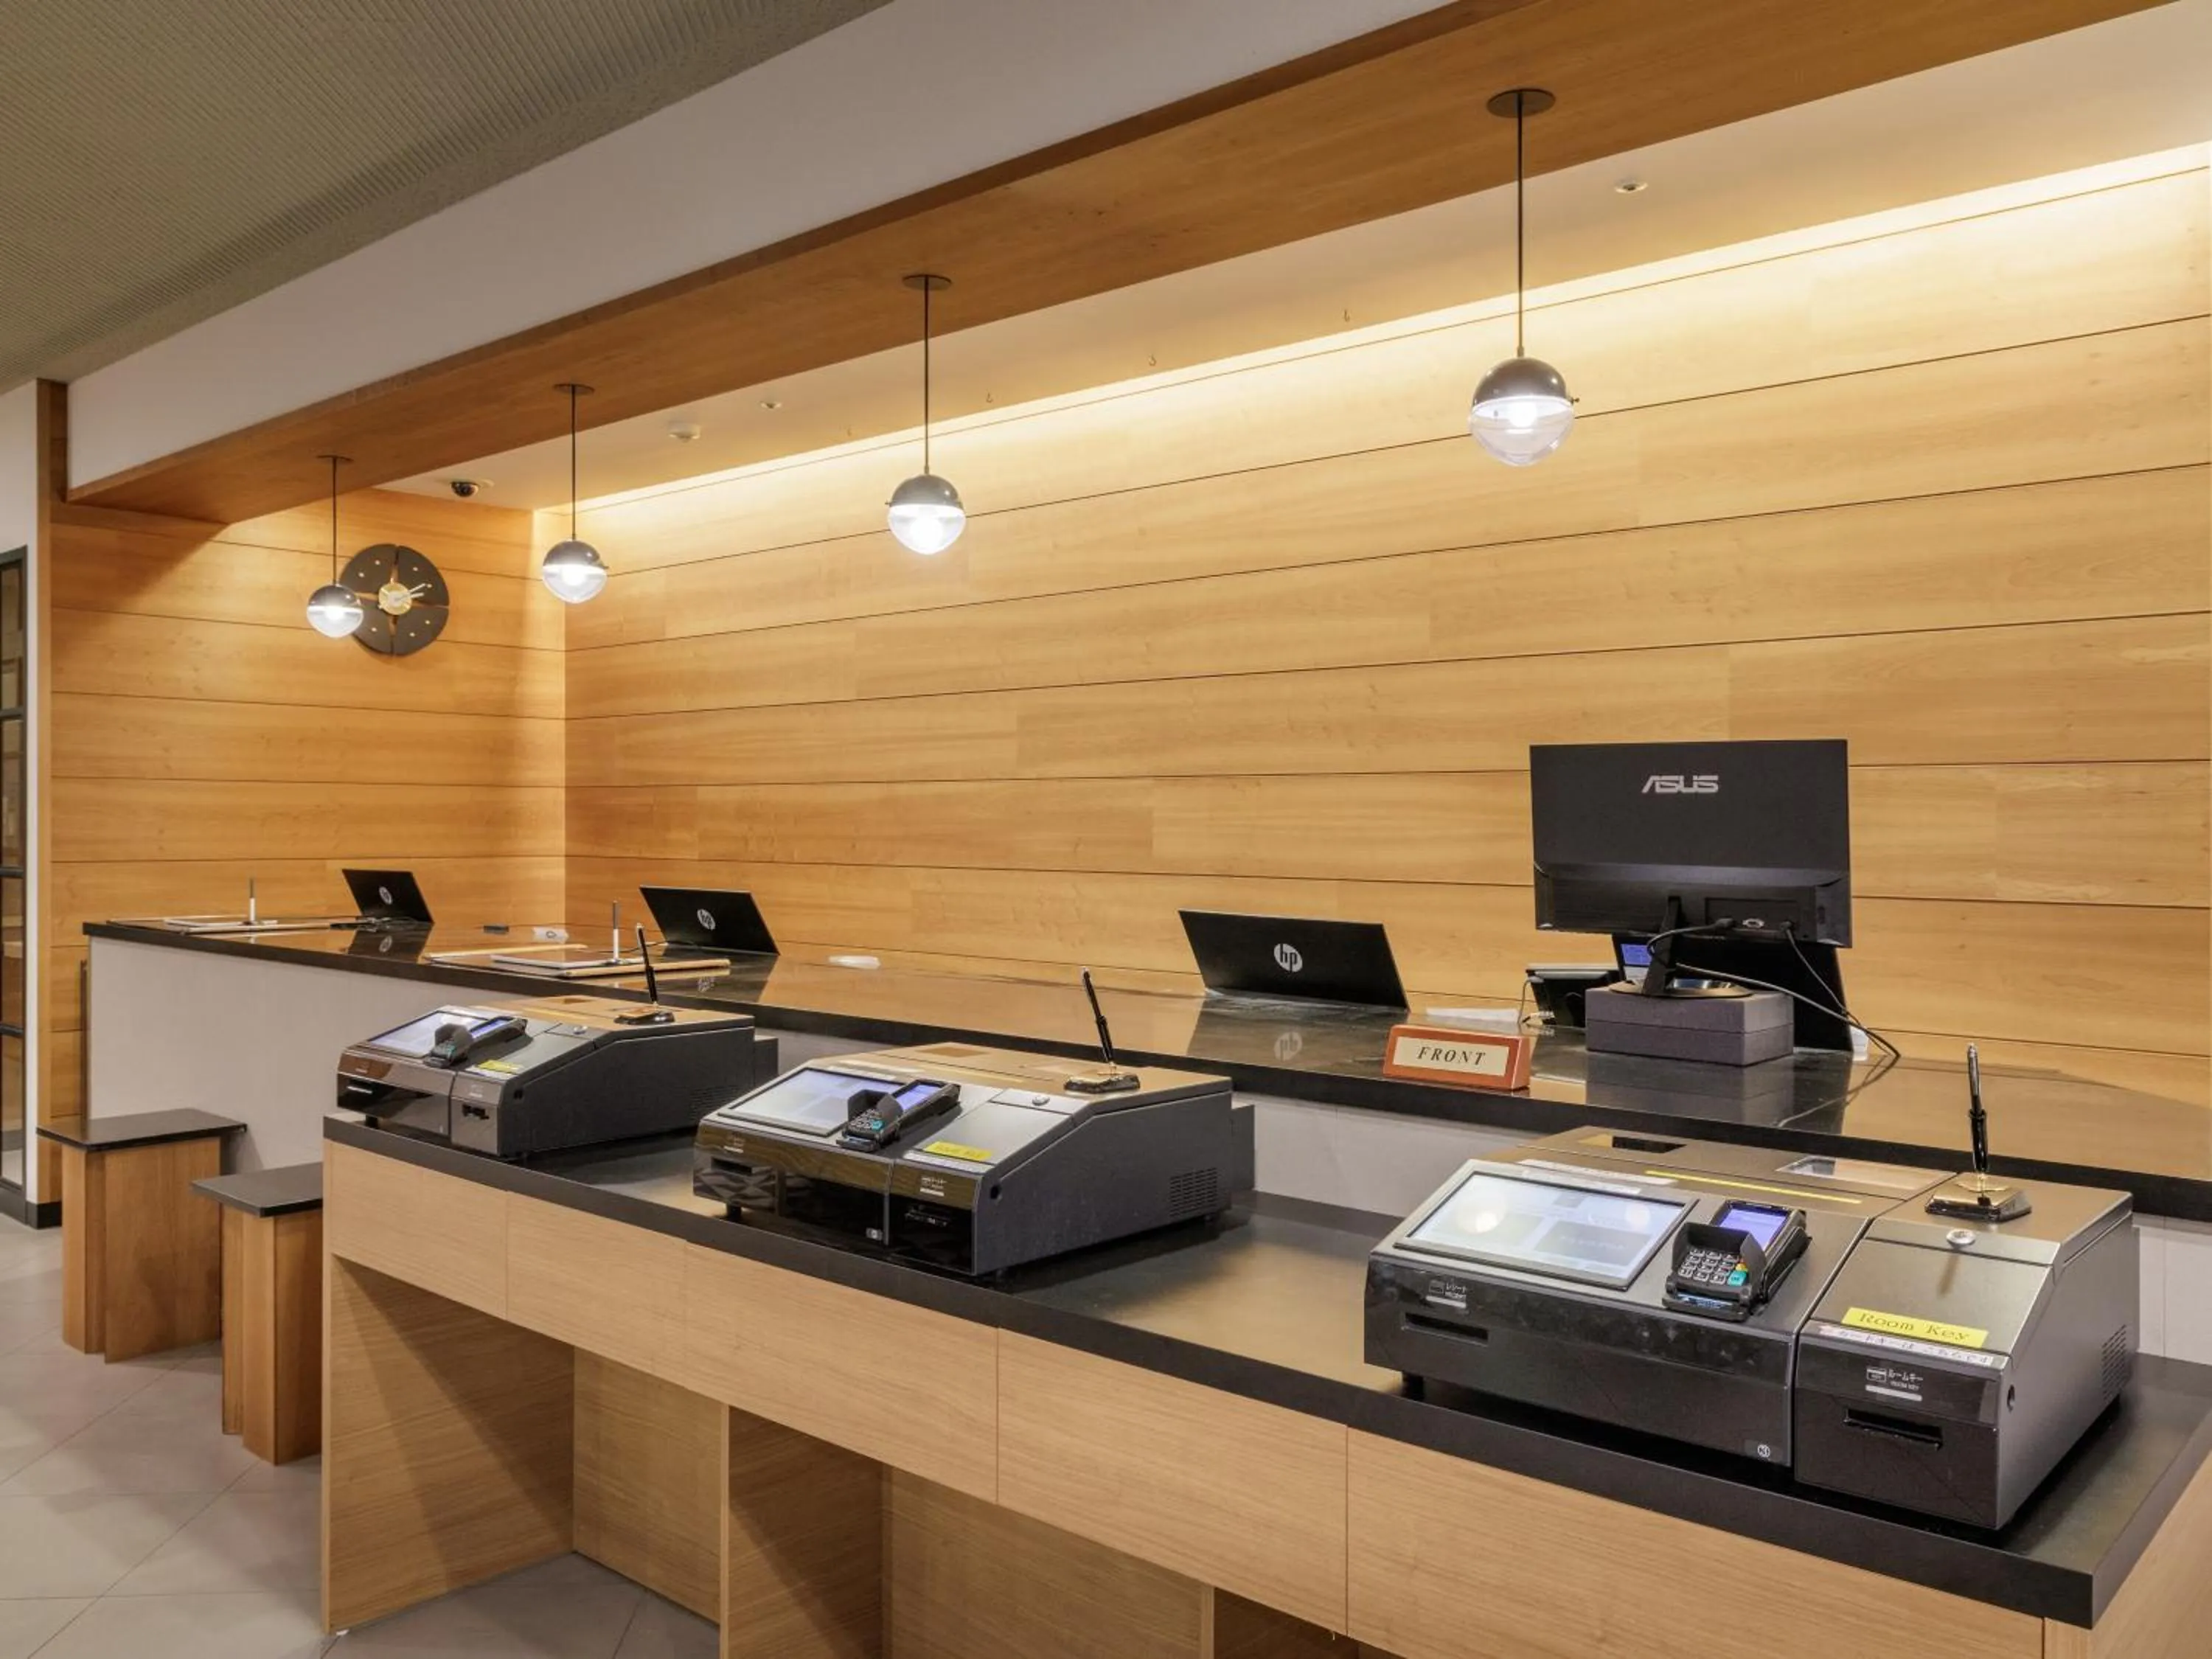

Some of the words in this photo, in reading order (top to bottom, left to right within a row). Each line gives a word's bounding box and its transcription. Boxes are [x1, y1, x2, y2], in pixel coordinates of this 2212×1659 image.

[1641, 775, 1719, 793] ASUS
[1276, 944, 1301, 972] hp
[1417, 1046, 1486, 1066] FRONT
[1859, 1312, 1915, 1332] Room
[1925, 1324, 1971, 1341] Key
